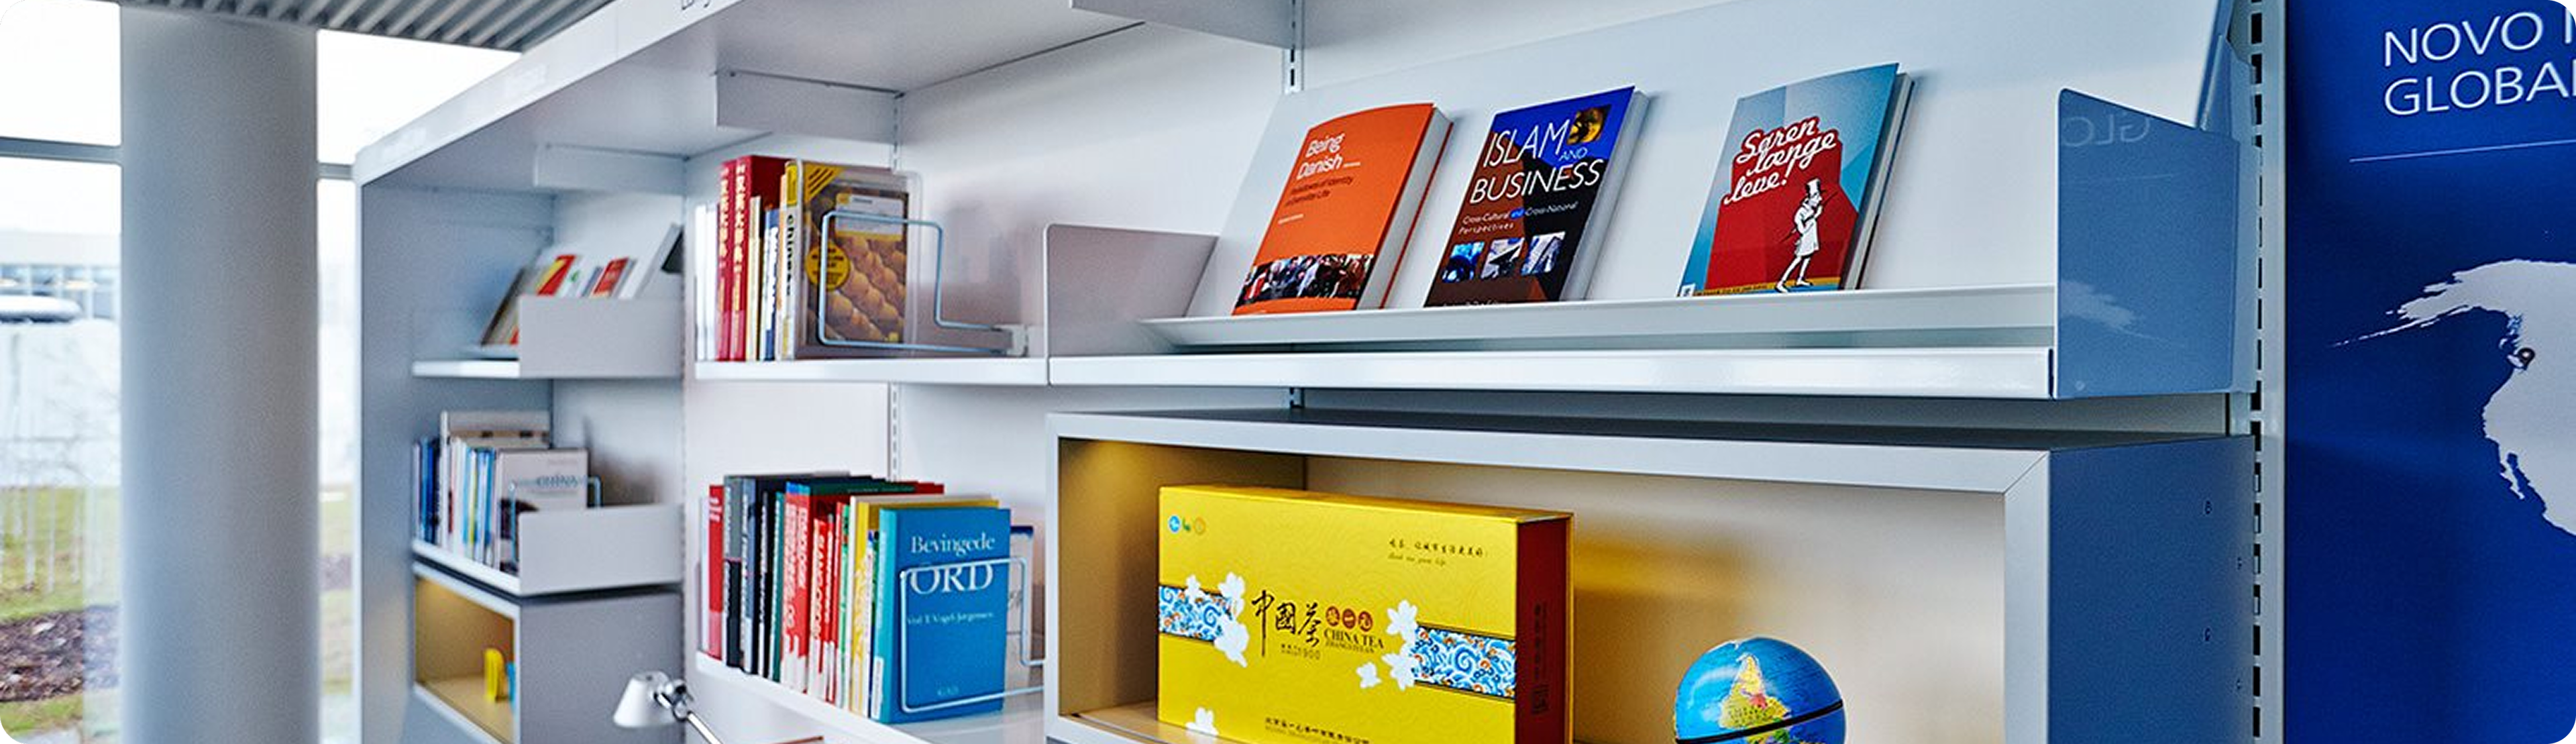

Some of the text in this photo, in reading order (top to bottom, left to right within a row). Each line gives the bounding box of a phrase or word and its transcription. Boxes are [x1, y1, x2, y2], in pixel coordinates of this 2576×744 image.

[2385, 11, 2544, 68] NOVO
[1305, 133, 1346, 158] Being
[1483, 119, 1570, 168] ISLAM
[1558, 147, 1587, 162] AND
[1296, 154, 1342, 180] Danish
[1469, 159, 1604, 204] BUSINESS
[910, 532, 996, 557] Bevingede
[1324, 629, 1384, 649] CHINA TEA
